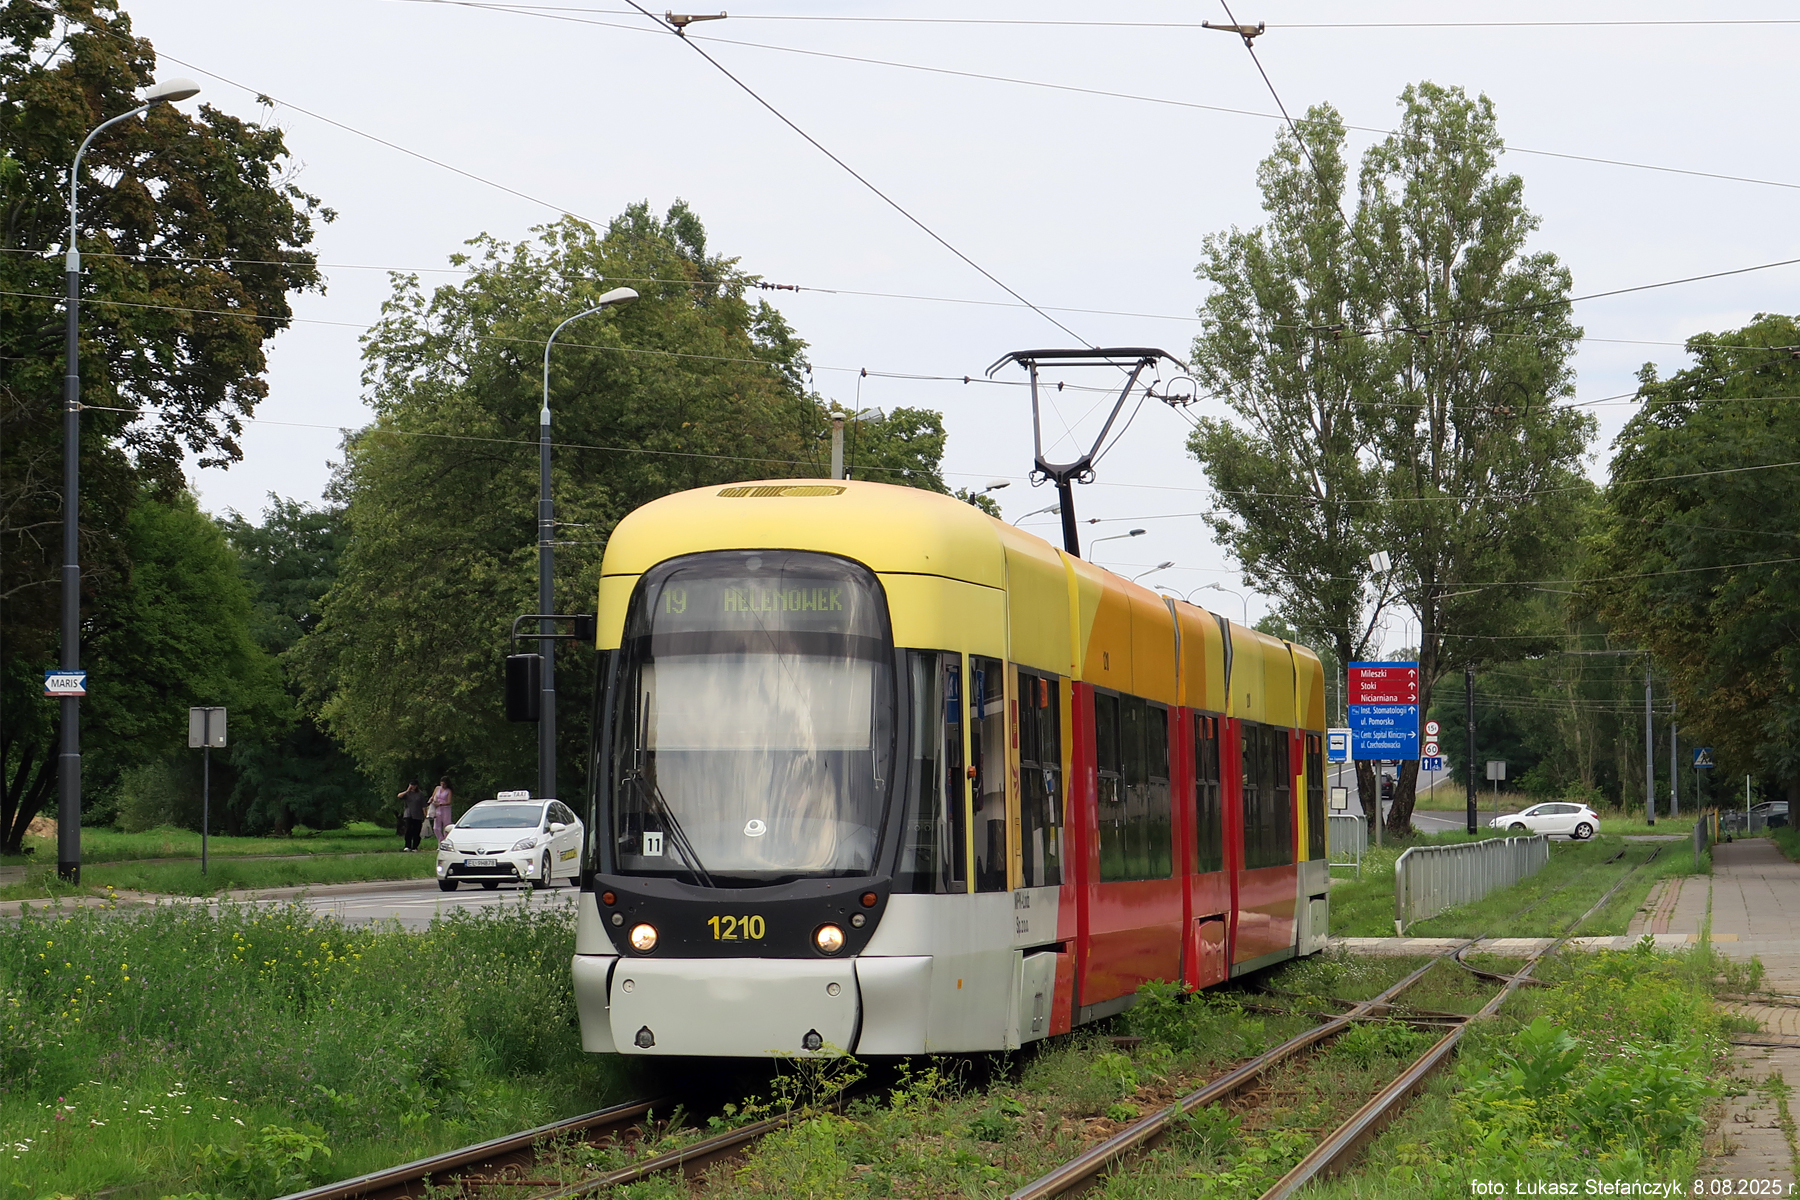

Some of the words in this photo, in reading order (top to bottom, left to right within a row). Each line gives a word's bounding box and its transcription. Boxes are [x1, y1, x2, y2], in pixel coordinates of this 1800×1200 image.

[662, 588, 687, 613] 19
[723, 585, 843, 612] HELENÓWEK
[1360, 669, 1387, 678] Mileszki
[51, 678, 78, 688] MARIS
[1360, 682, 1377, 690] Stoki
[1360, 694, 1398, 702] Niciarniana
[1372, 706, 1407, 716] Stomatologii
[1368, 717, 1395, 726] Pomorska
[1427, 745, 1437, 753] 60
[647, 838, 660, 852] 11
[707, 915, 766, 940] 1210
